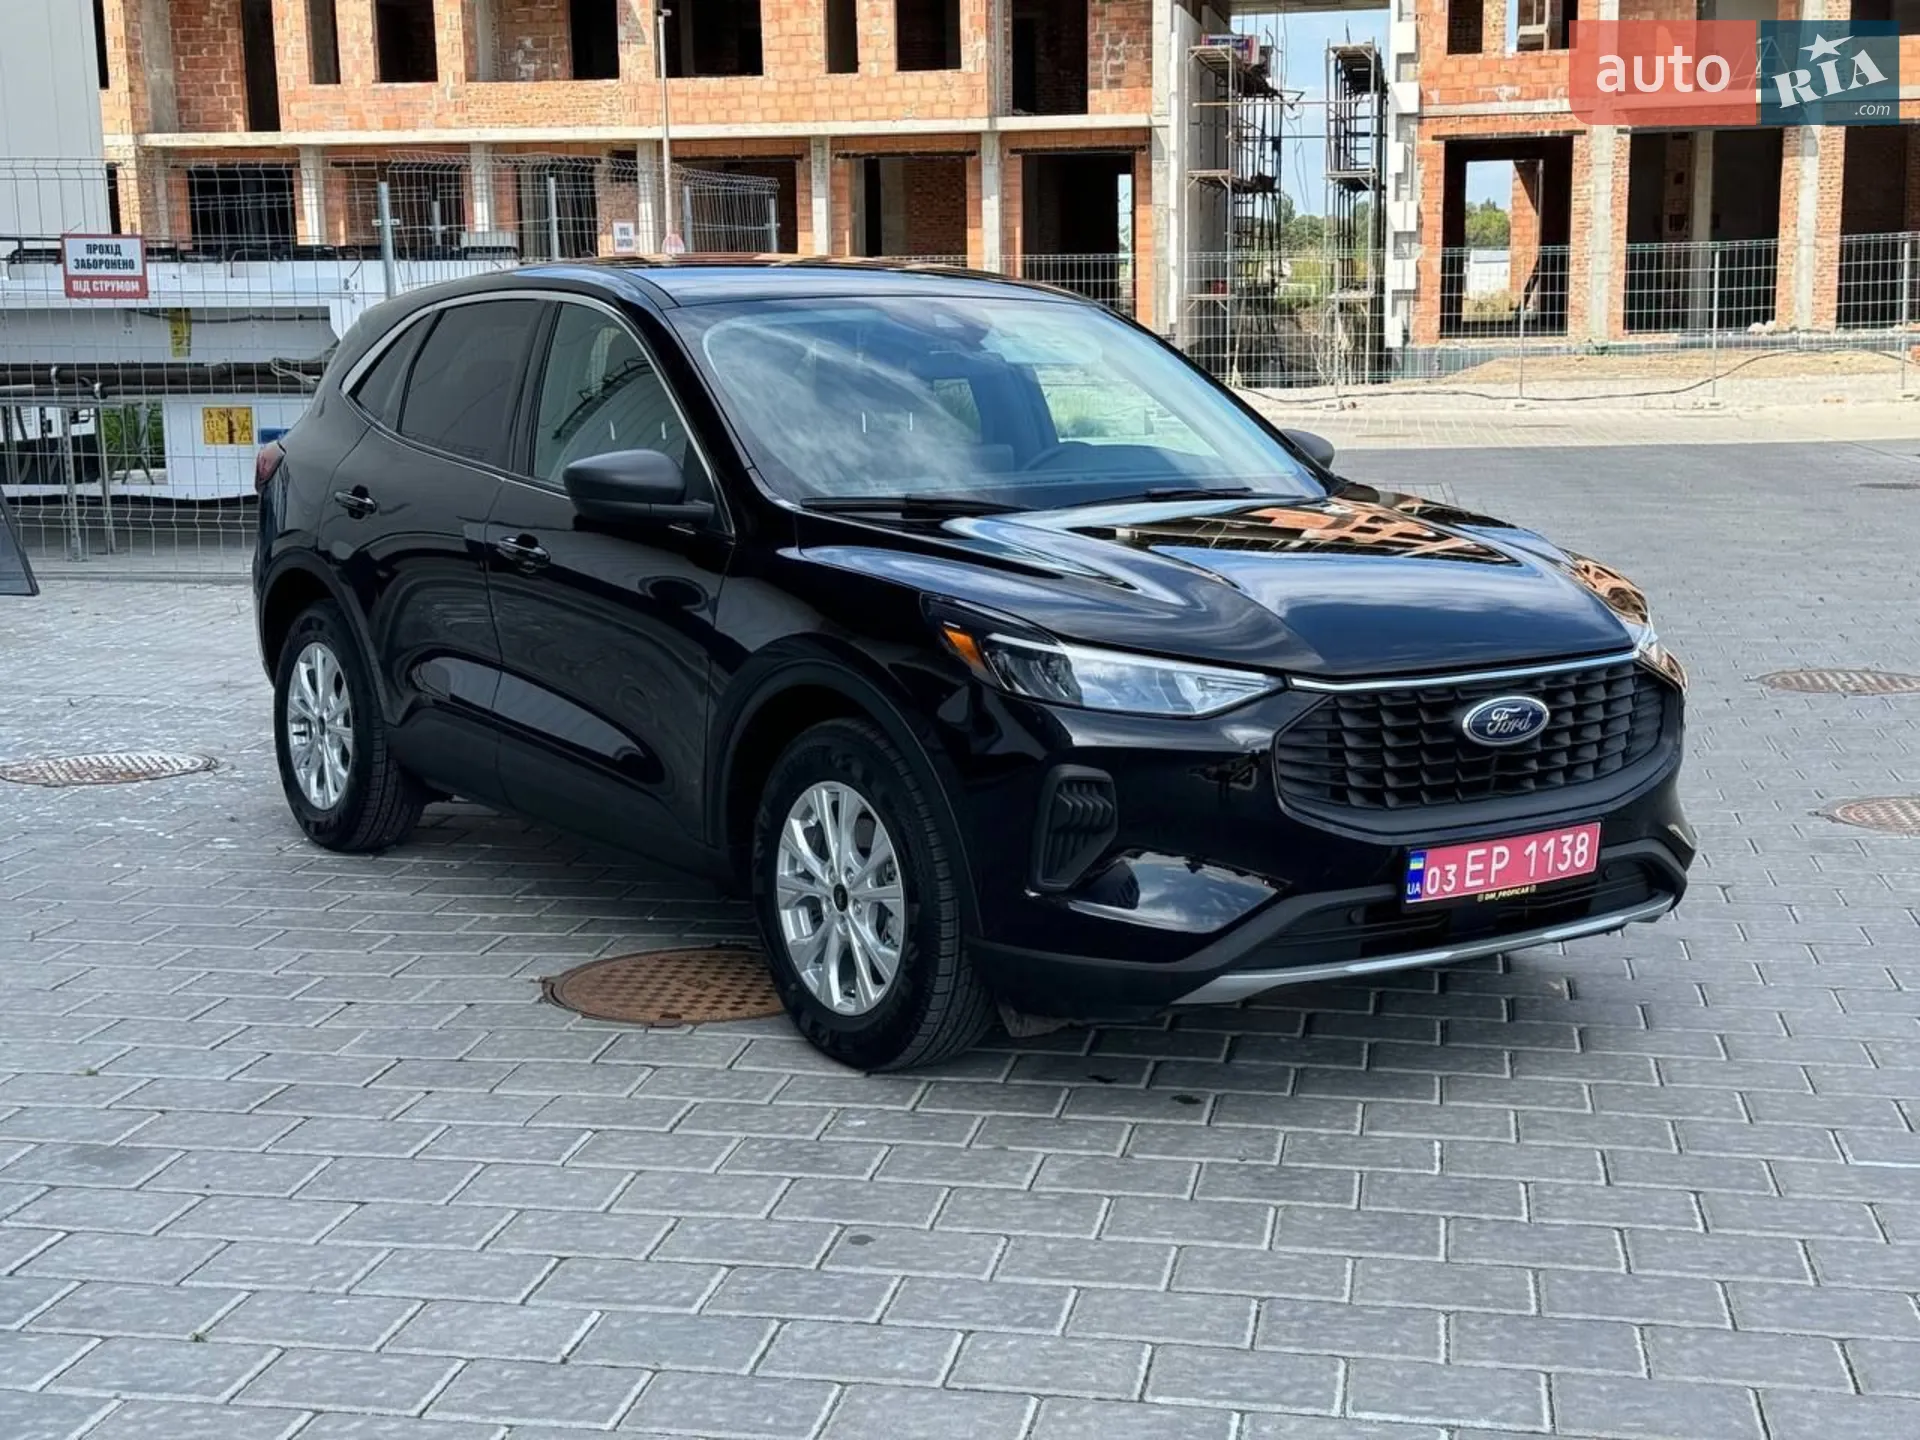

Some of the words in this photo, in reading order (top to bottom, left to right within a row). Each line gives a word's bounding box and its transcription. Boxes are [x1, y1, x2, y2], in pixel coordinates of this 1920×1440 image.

[86, 244, 122, 256] ПРОХІД
[74, 259, 135, 270] ЗАБОРОНЕНО
[72, 280, 91, 293] ПІД
[92, 281, 139, 292] СТРУМОМ
[1486, 707, 1533, 735] Ford
[1407, 882, 1422, 895] UA
[1426, 864, 1458, 895] 03
[1465, 845, 1510, 887] EP
[1523, 832, 1590, 878] 1138
